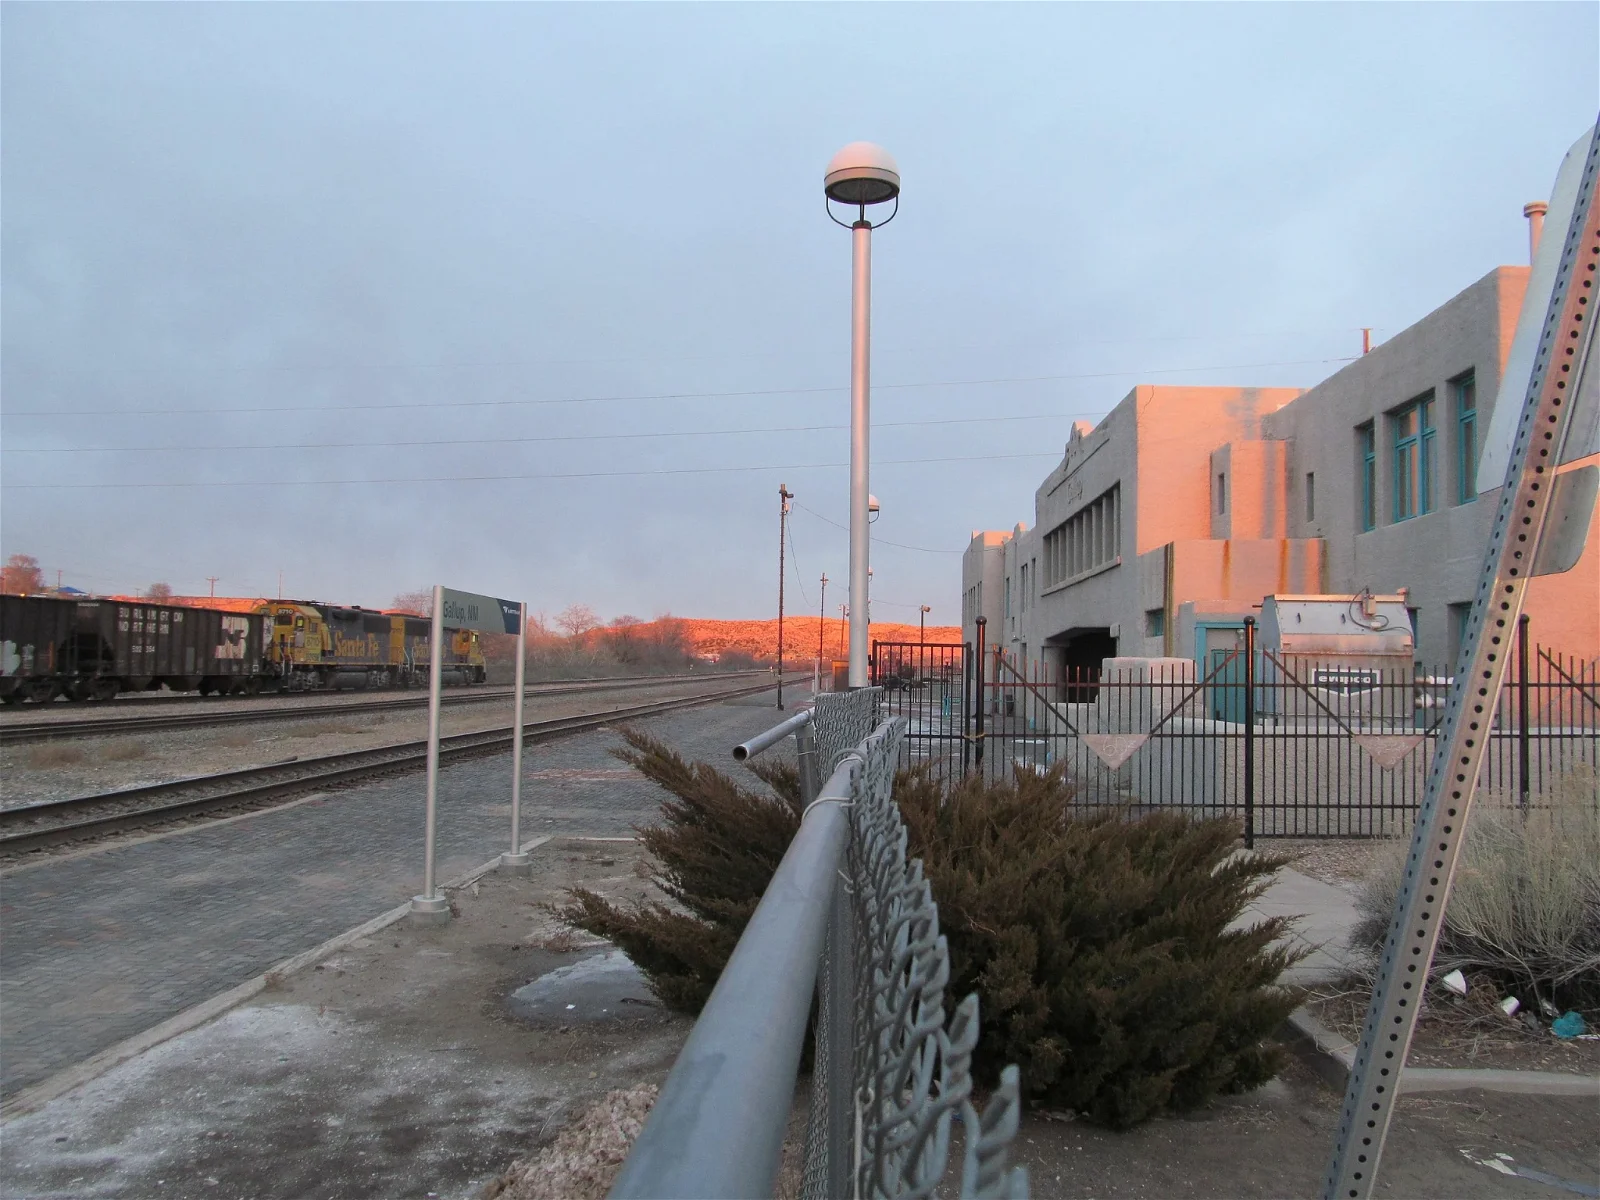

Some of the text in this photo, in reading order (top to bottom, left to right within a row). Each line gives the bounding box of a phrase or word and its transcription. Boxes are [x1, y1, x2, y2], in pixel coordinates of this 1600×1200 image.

[118, 607, 184, 623] BURLINGTON
[443, 601, 480, 625] Gallup, NM
[118, 621, 170, 635] NORTHERN
[334, 629, 380, 657] Santa Fe
